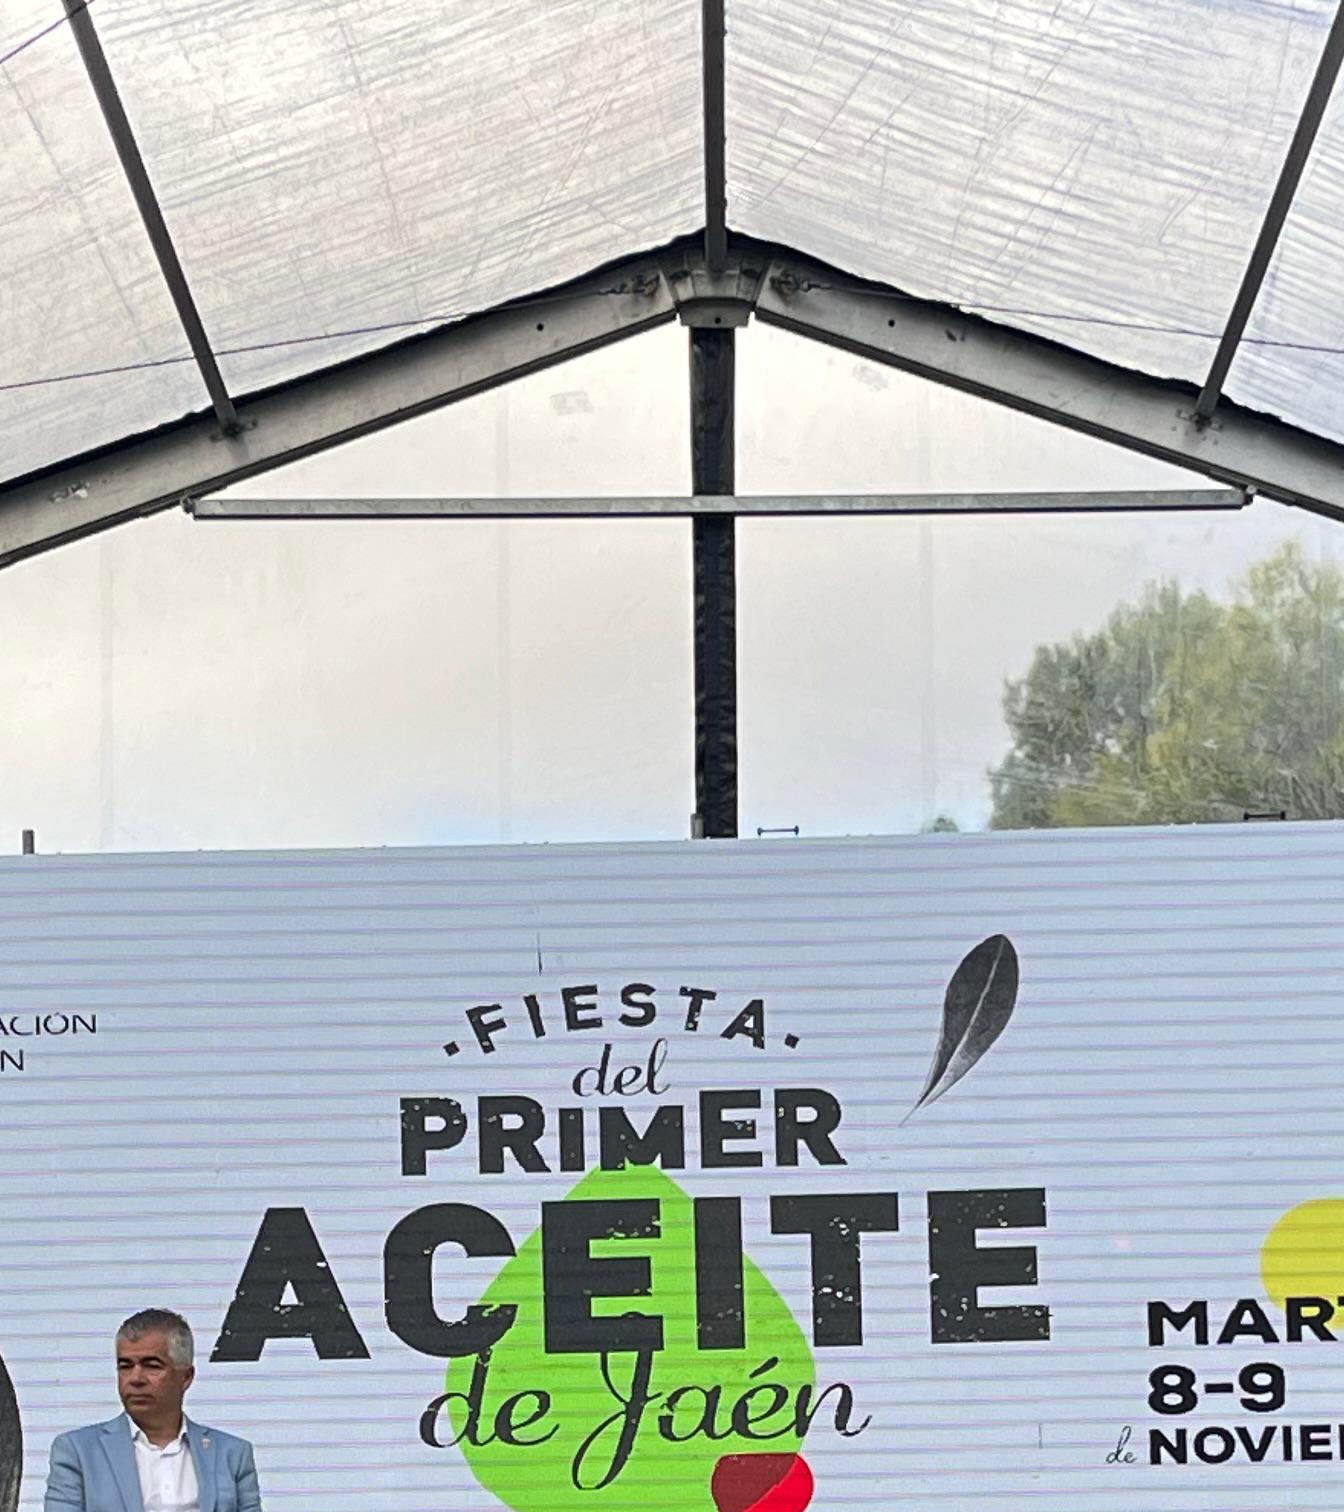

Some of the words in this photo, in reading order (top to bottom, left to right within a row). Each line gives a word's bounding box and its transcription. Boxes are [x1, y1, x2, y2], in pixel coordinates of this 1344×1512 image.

[572, 1037, 670, 1097] del
[399, 1087, 848, 1177] PRIMER
[208, 1187, 1053, 1363] ACEITE
[419, 1347, 561, 1449] de
[572, 1313, 873, 1491] Jaén
[1147, 1362, 1287, 1415] 8-9
